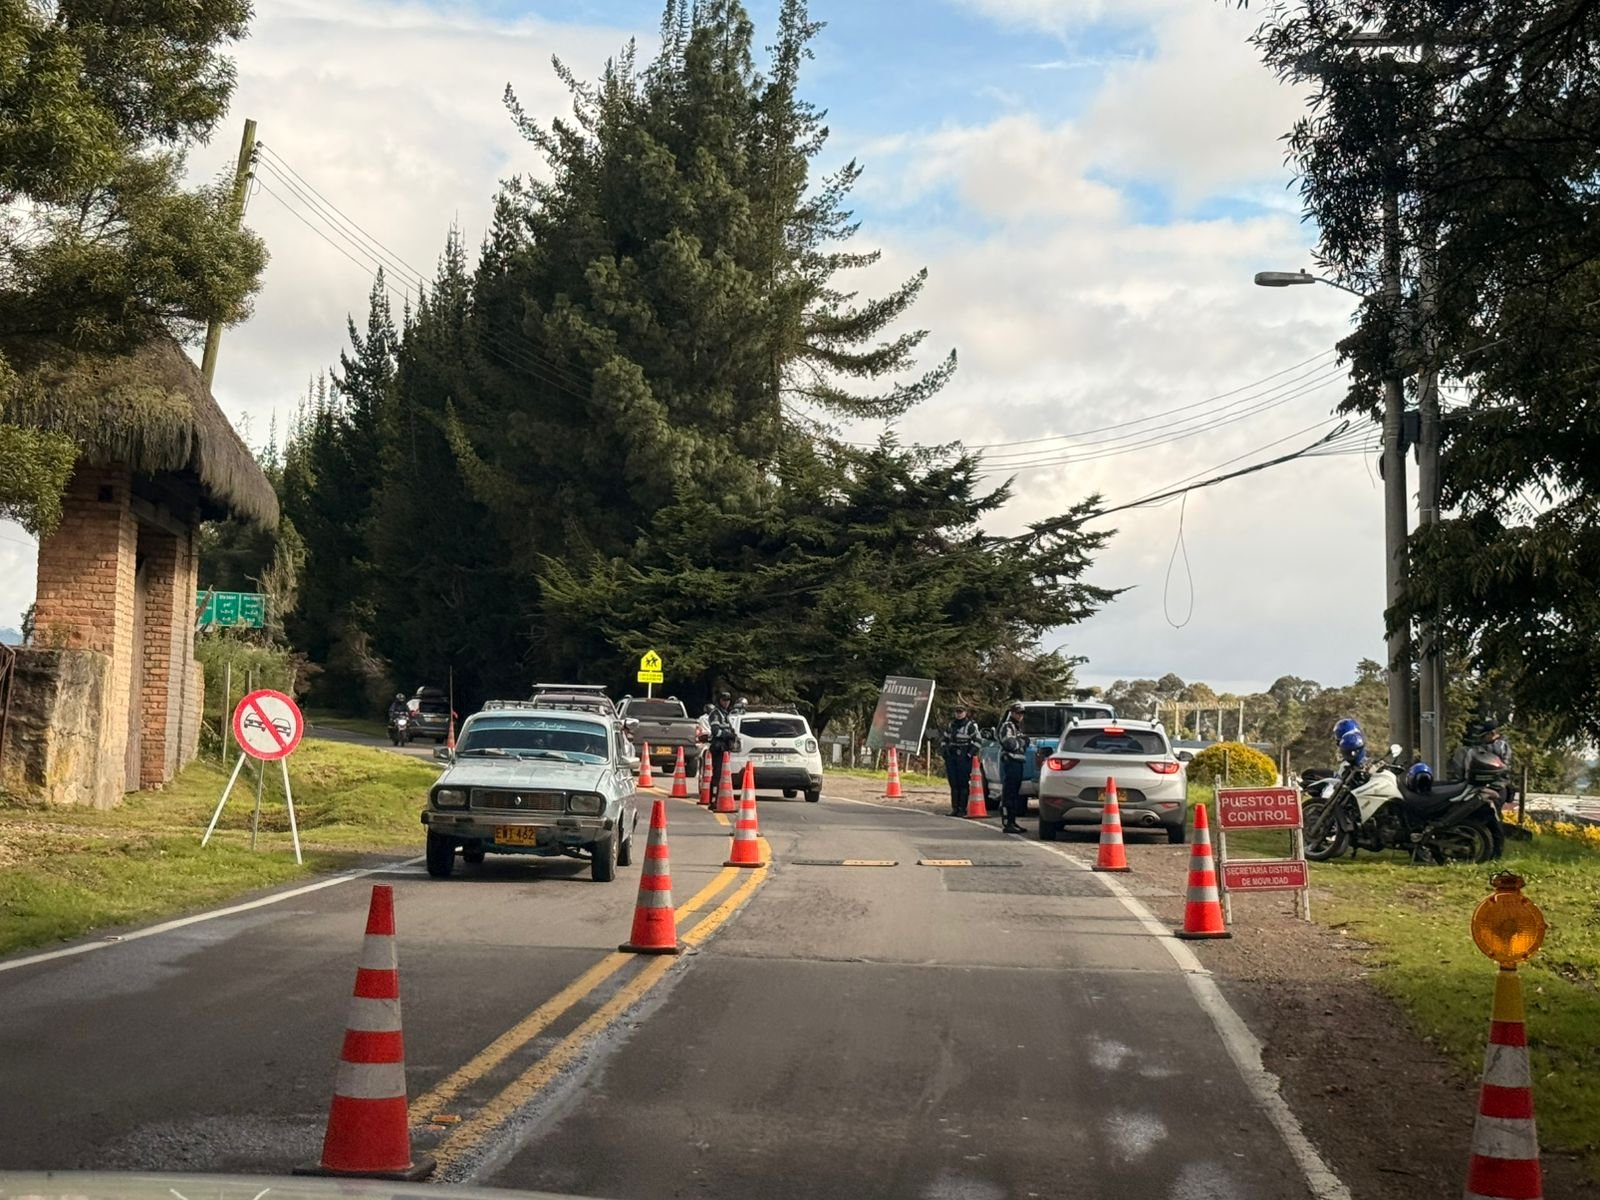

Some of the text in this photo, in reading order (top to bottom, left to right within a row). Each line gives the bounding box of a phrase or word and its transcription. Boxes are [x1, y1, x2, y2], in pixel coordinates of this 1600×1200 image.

[1221, 794, 1296, 808] PUESTO DE
[1227, 810, 1292, 822] CONTROL
[1269, 864, 1302, 874] DISTRITAL
[1242, 877, 1289, 886] DE MOVILIDAD
